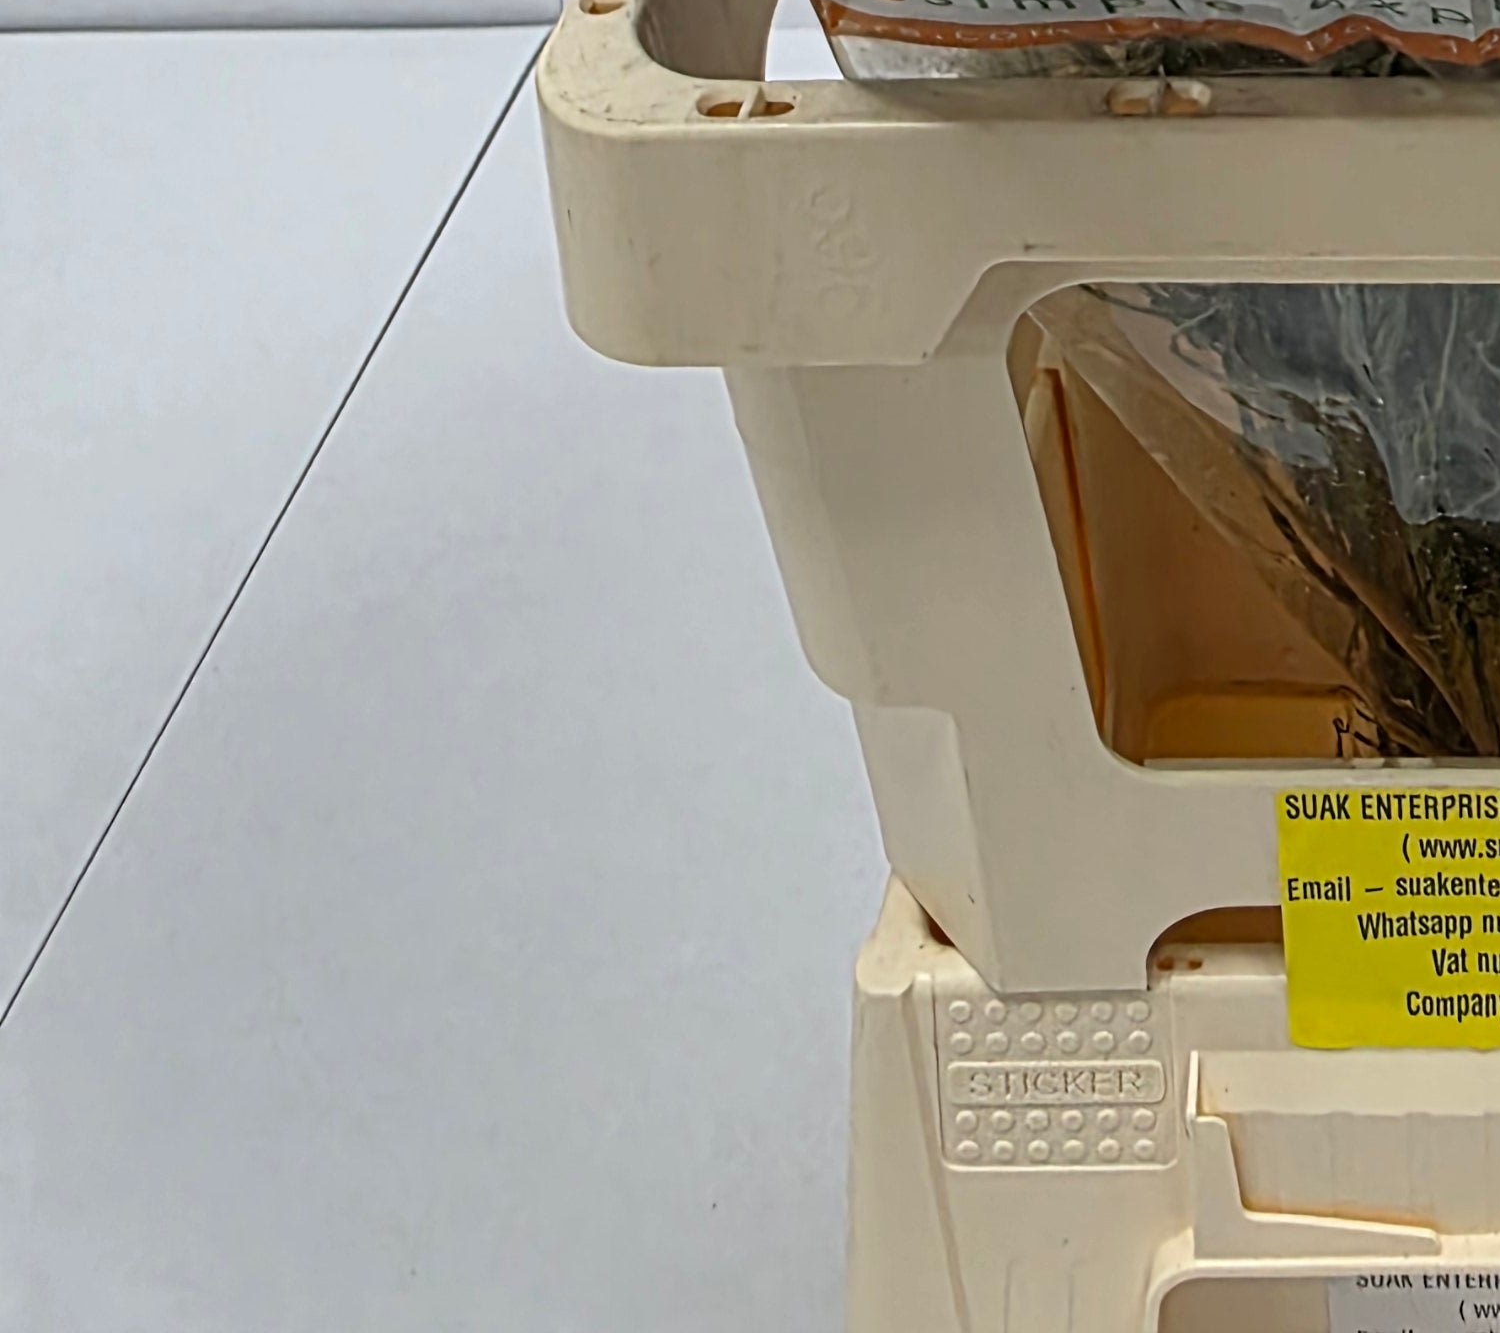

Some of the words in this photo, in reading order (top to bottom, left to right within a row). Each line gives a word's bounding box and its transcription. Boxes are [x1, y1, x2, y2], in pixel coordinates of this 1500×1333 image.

[1285, 794, 1350, 820] SUAK
[1287, 876, 1351, 901] Email
[1357, 911, 1472, 940] Whatsapp
[1432, 948, 1468, 976] Vat
[968, 1068, 1144, 1100] STICKER
